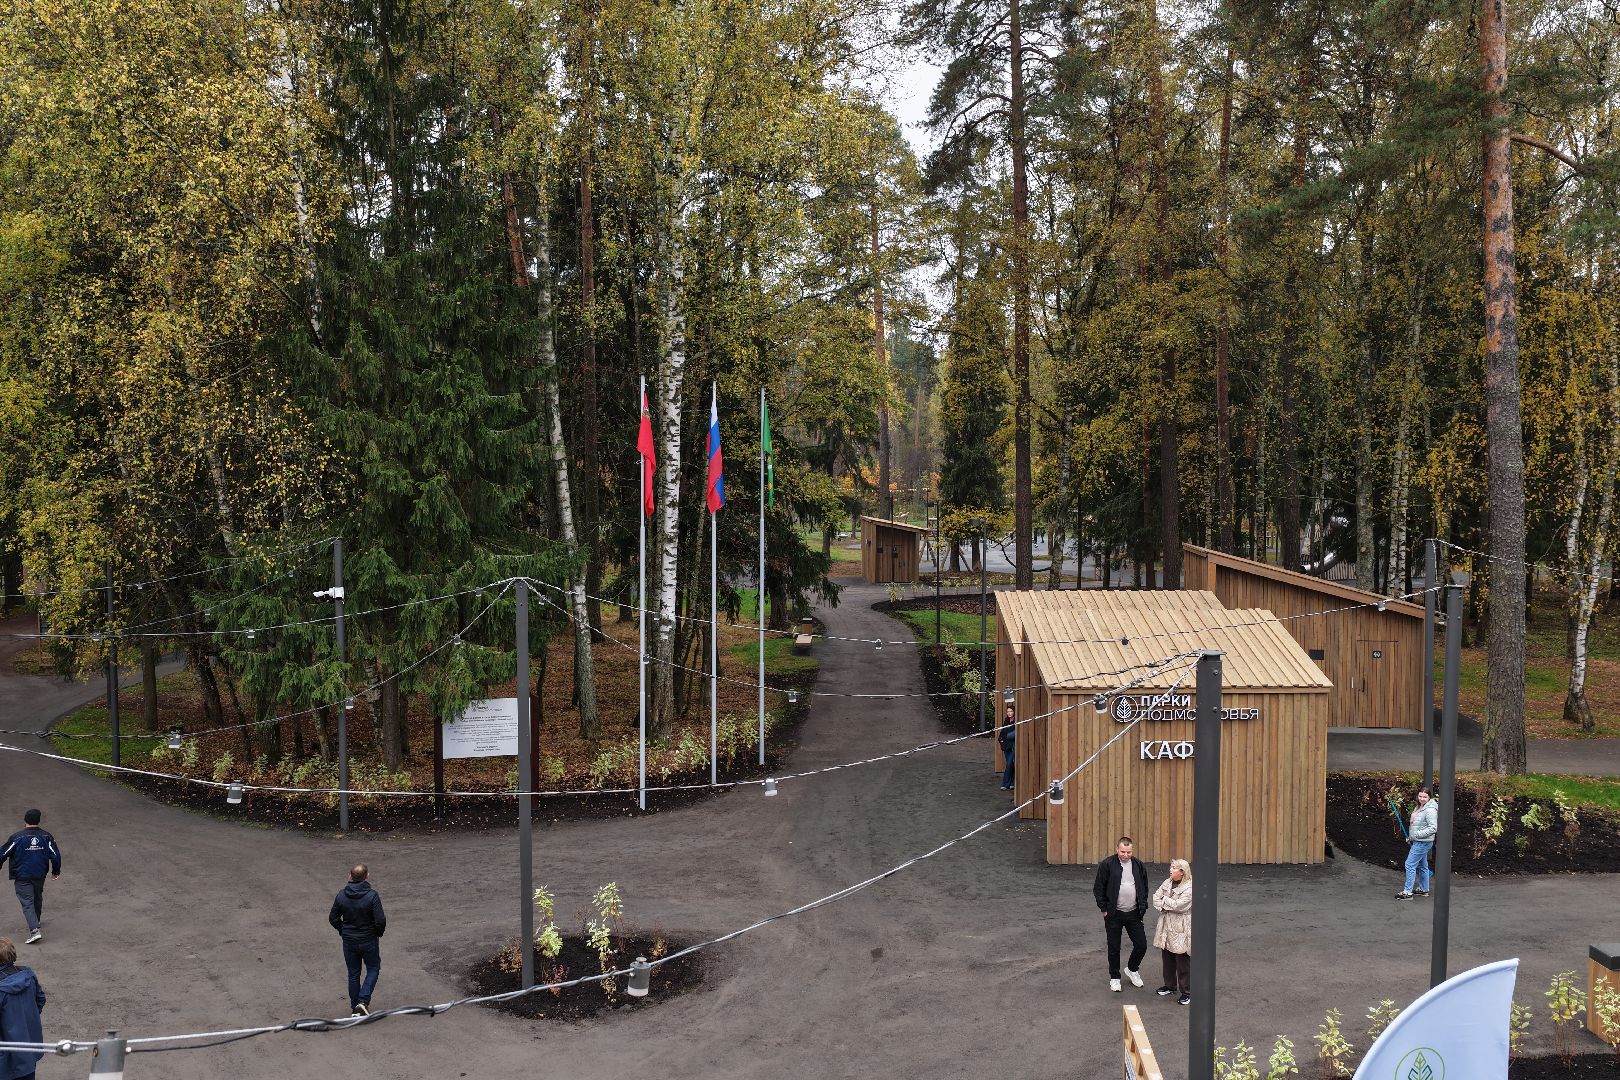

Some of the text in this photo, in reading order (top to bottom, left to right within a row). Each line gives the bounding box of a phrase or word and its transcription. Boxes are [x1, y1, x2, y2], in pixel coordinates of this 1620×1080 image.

[1141, 695, 1191, 707] ПАРКИ
[1141, 708, 1259, 721] ПОДМООВЬЯ
[1140, 741, 1194, 760] КАФ
